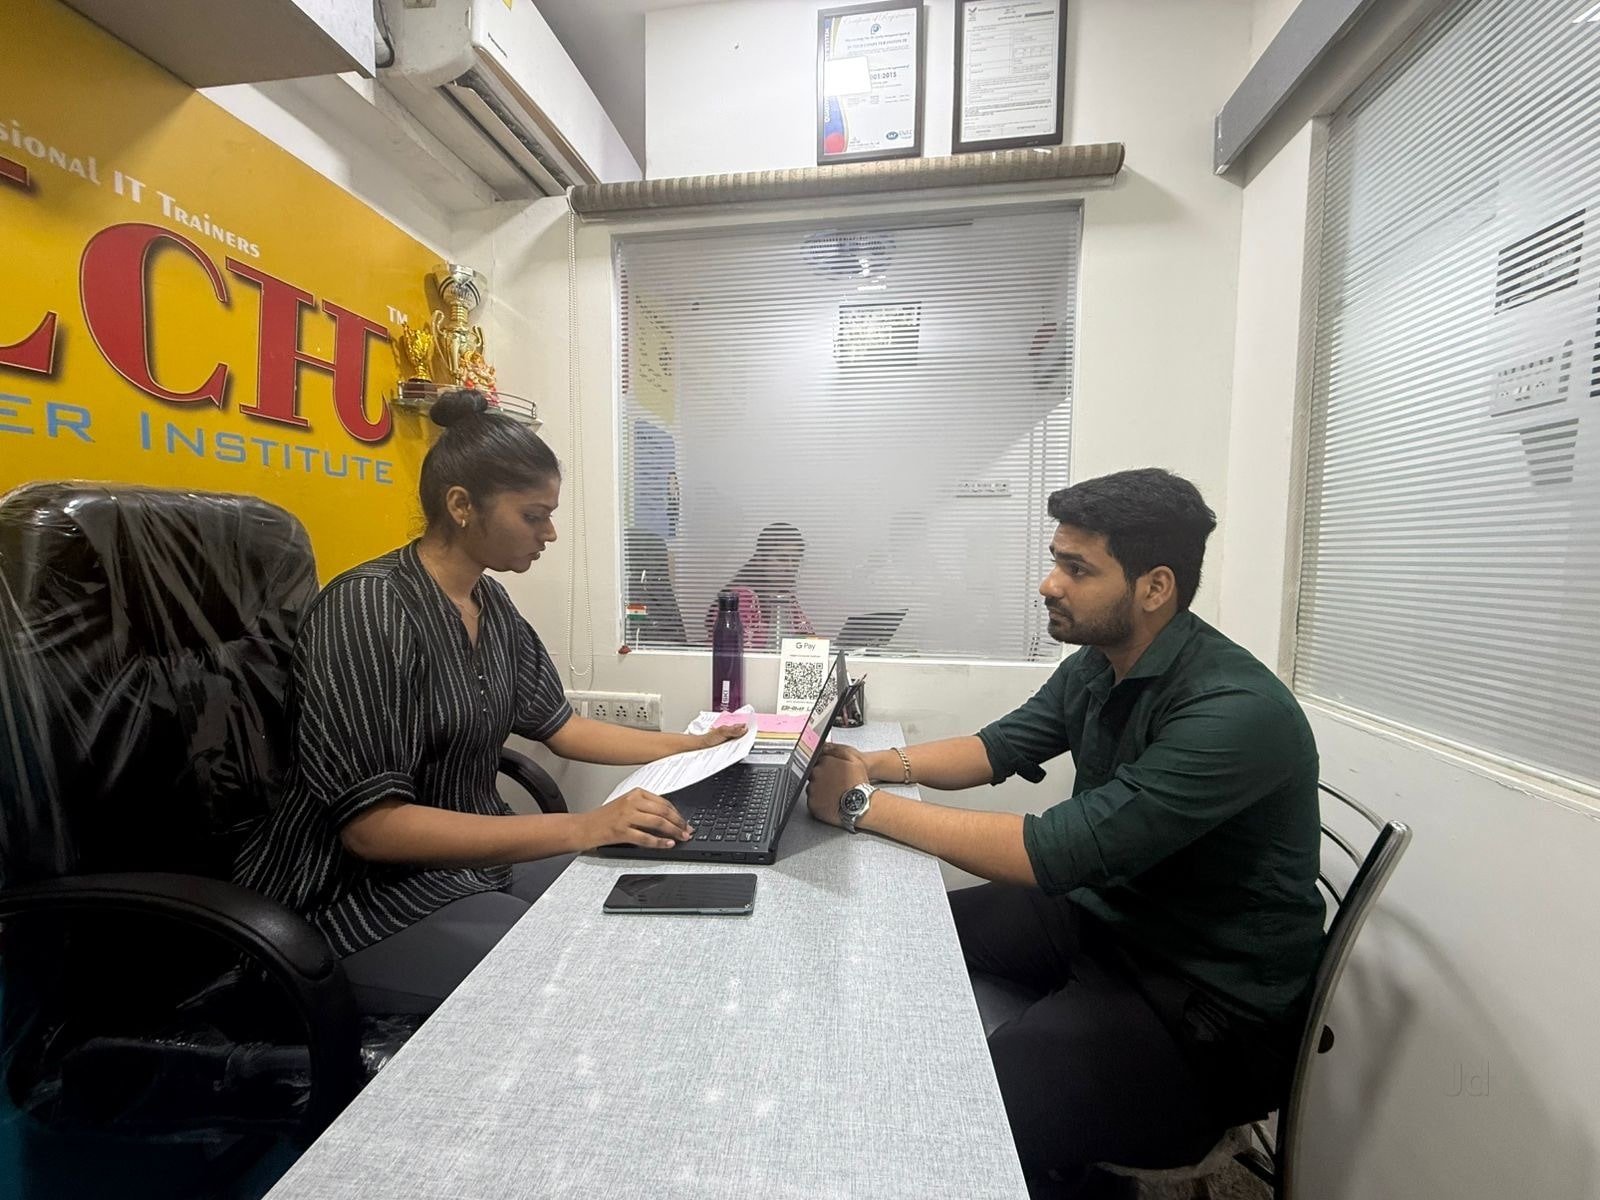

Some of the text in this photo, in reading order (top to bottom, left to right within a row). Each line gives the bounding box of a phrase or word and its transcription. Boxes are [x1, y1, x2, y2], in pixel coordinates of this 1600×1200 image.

[114, 170, 146, 203] IT
[386, 305, 408, 325] TM
[140, 411, 393, 484] INSTITUTE
[804, 643, 816, 652] Pay
